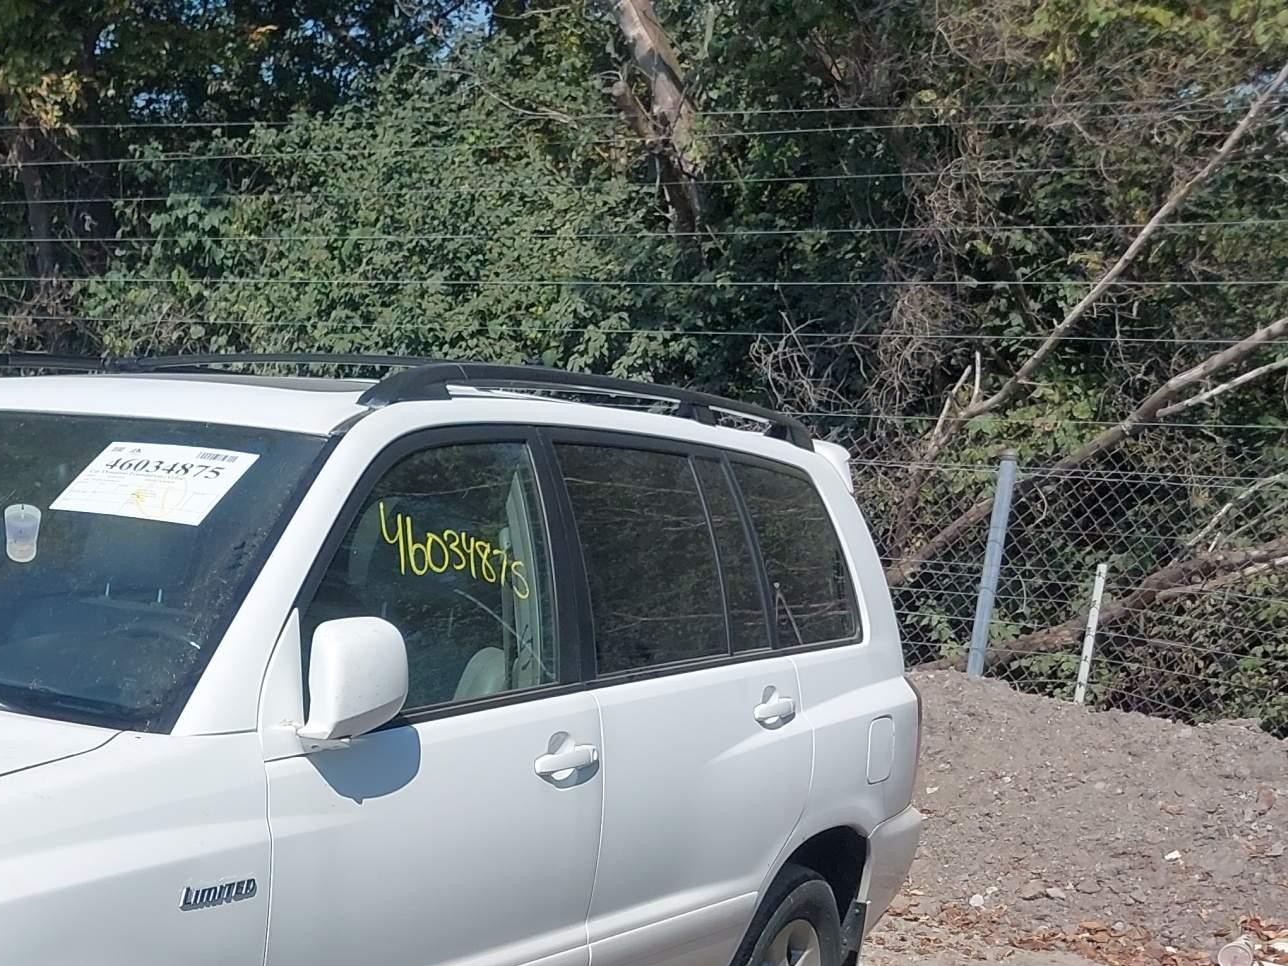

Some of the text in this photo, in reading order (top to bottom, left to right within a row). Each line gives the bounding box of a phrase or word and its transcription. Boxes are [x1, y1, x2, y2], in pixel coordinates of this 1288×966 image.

[105, 456, 226, 480] 46034875
[378, 501, 530, 600] 46034875
[179, 877, 258, 912] LIMITED
